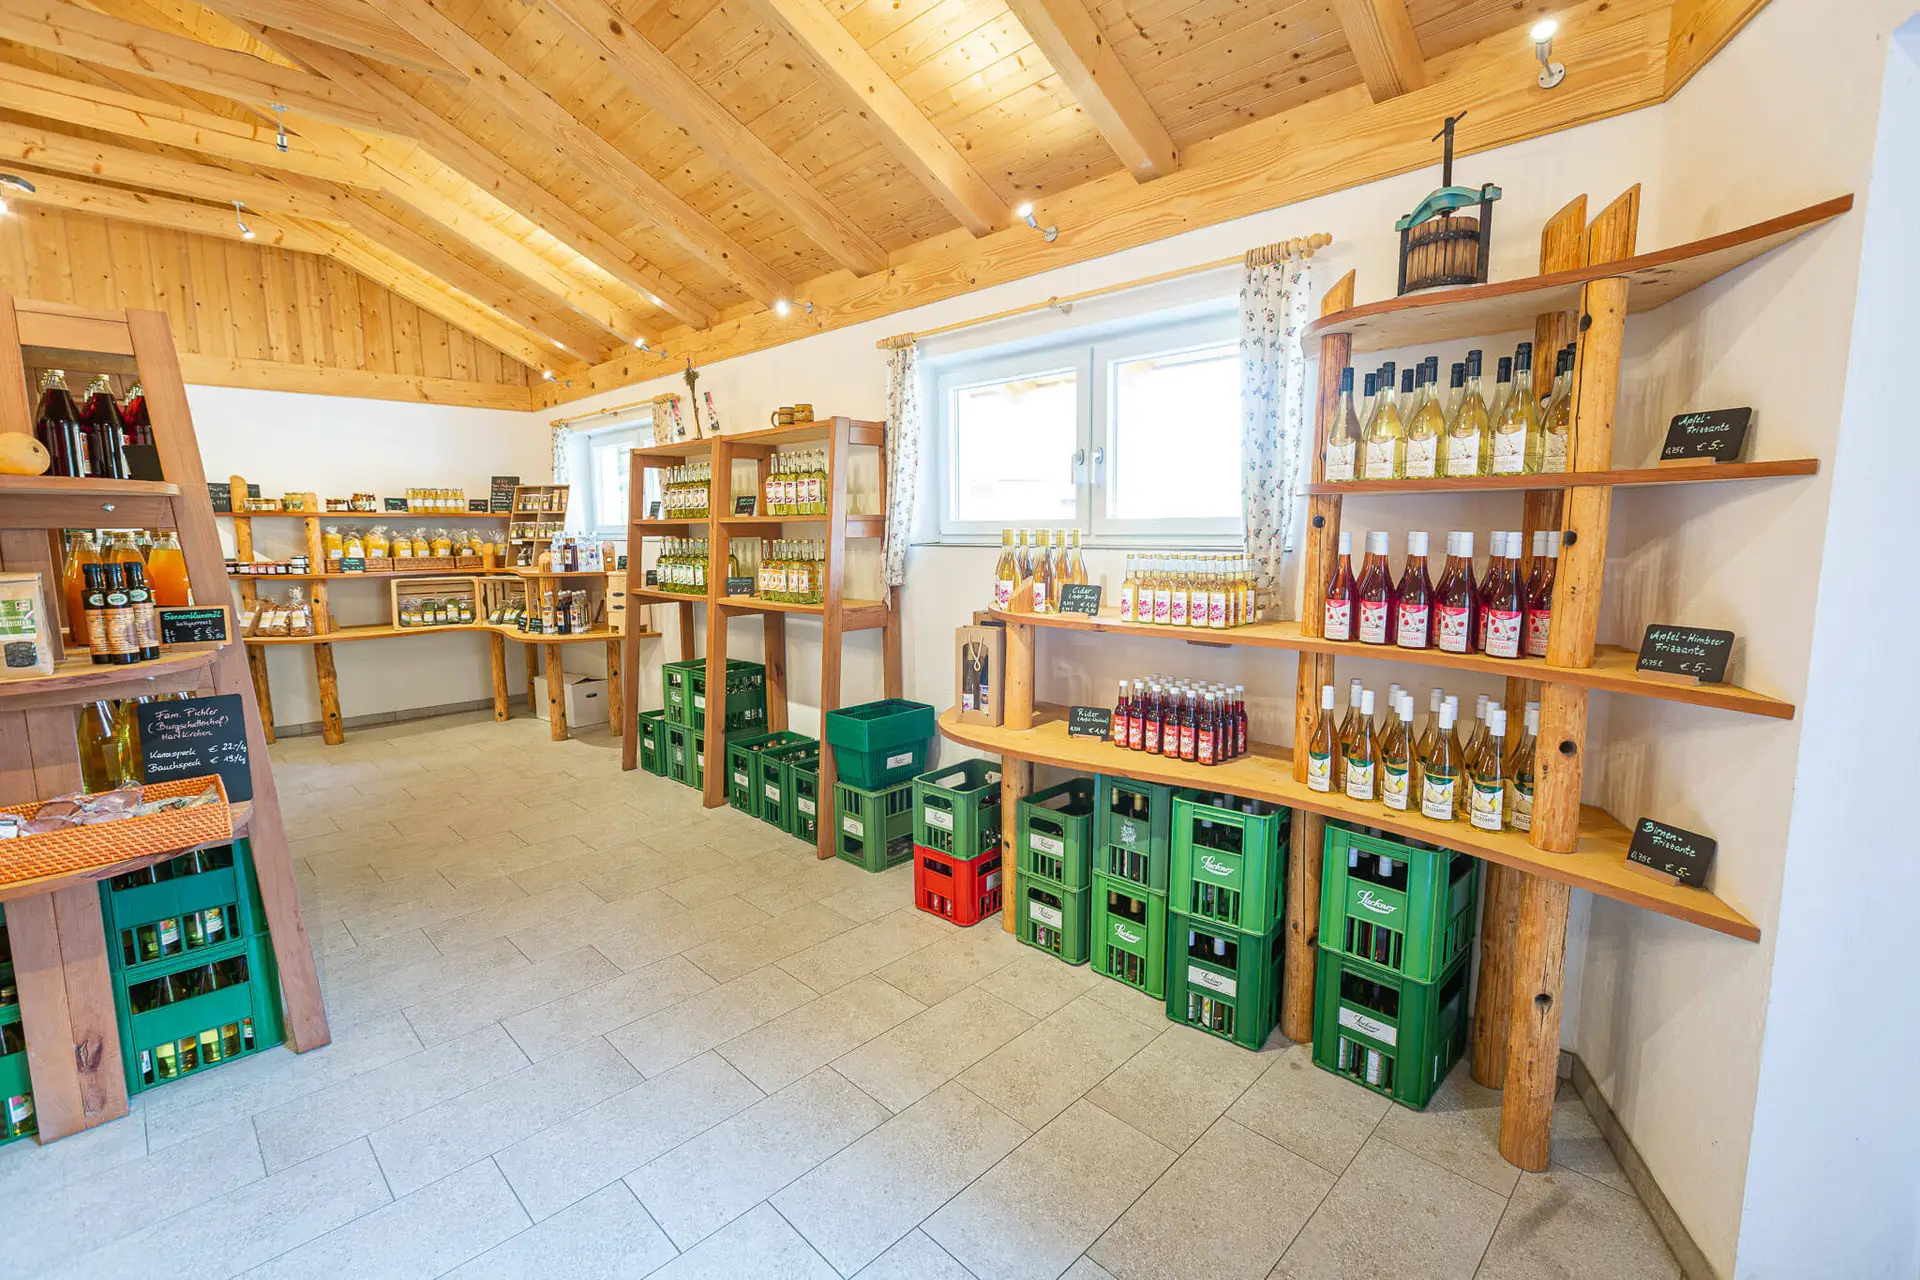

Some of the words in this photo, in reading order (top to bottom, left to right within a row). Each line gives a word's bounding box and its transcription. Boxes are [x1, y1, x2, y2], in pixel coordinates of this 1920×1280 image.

[1686, 422, 1731, 435] Frizzante
[1696, 442, 1707, 451] €
[1655, 642, 1706, 656] Frizzante
[1680, 662, 1690, 671] €
[155, 709, 181, 720] Fam.
[207, 745, 218, 753] €
[148, 758, 202, 773] Bauchspeck
[210, 756, 220, 764] €
[1651, 836, 1696, 857] Frizzante
[1665, 863, 1674, 872] €
[1357, 889, 1397, 914] Lackner
